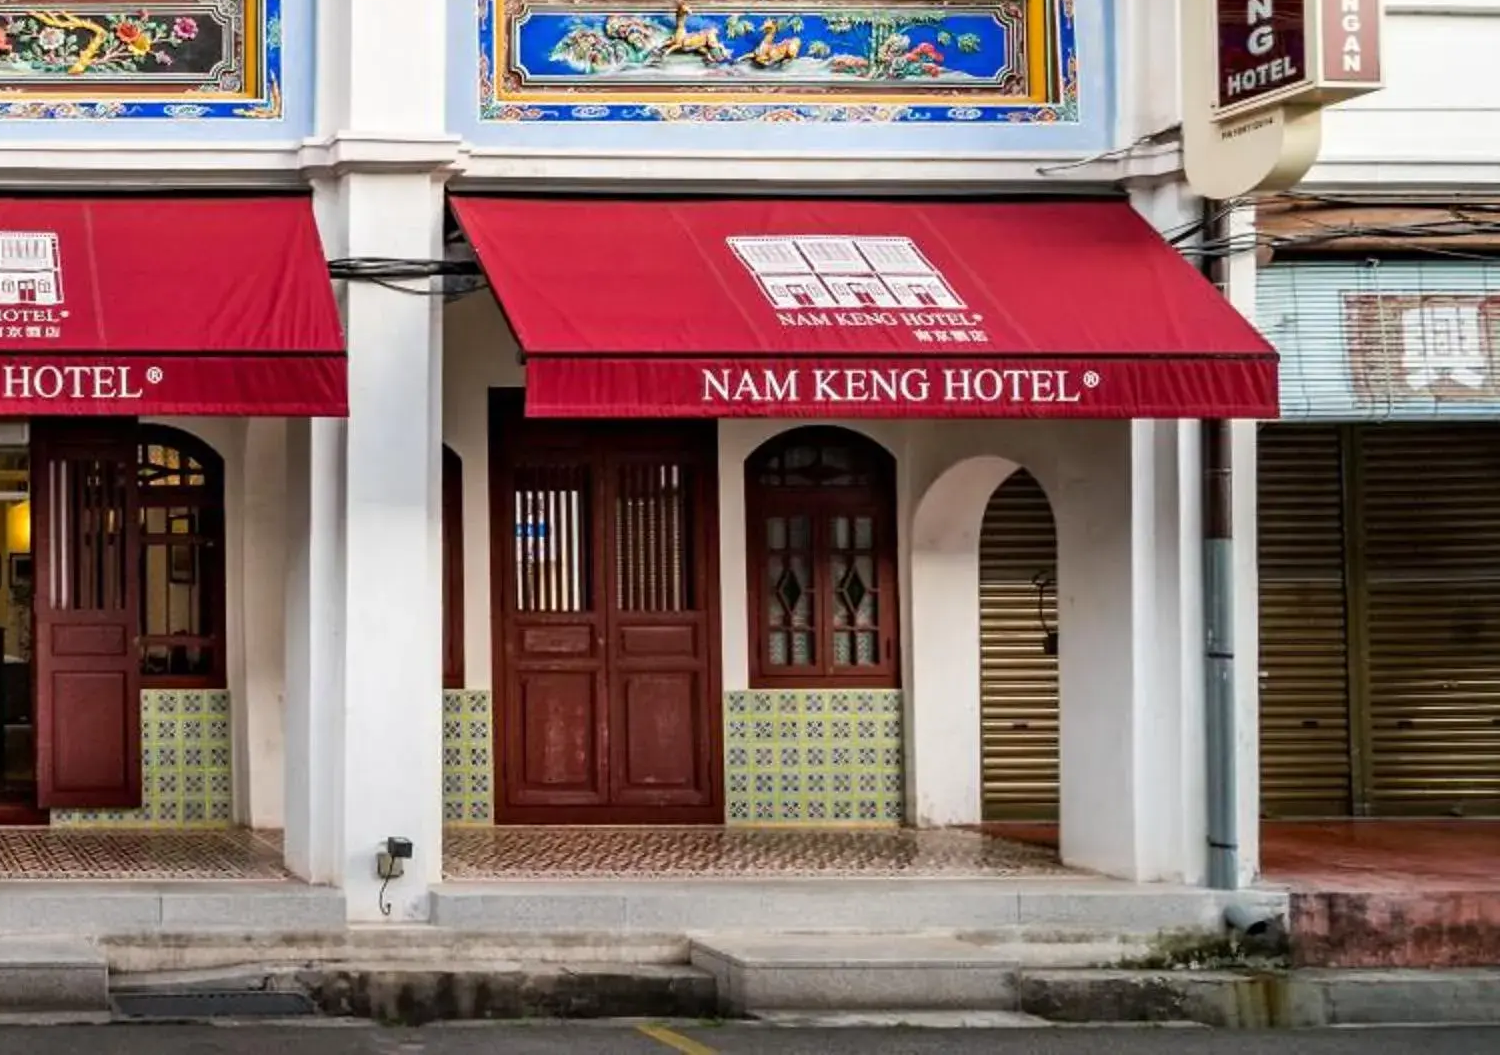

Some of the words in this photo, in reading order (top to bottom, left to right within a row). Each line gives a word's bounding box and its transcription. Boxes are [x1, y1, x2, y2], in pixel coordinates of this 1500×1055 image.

[1227, 56, 1297, 97] HOTEL
[776, 312, 833, 326] NAM
[835, 312, 898, 326] KENG
[701, 369, 800, 401] NAM
[813, 370, 930, 402] KENG
